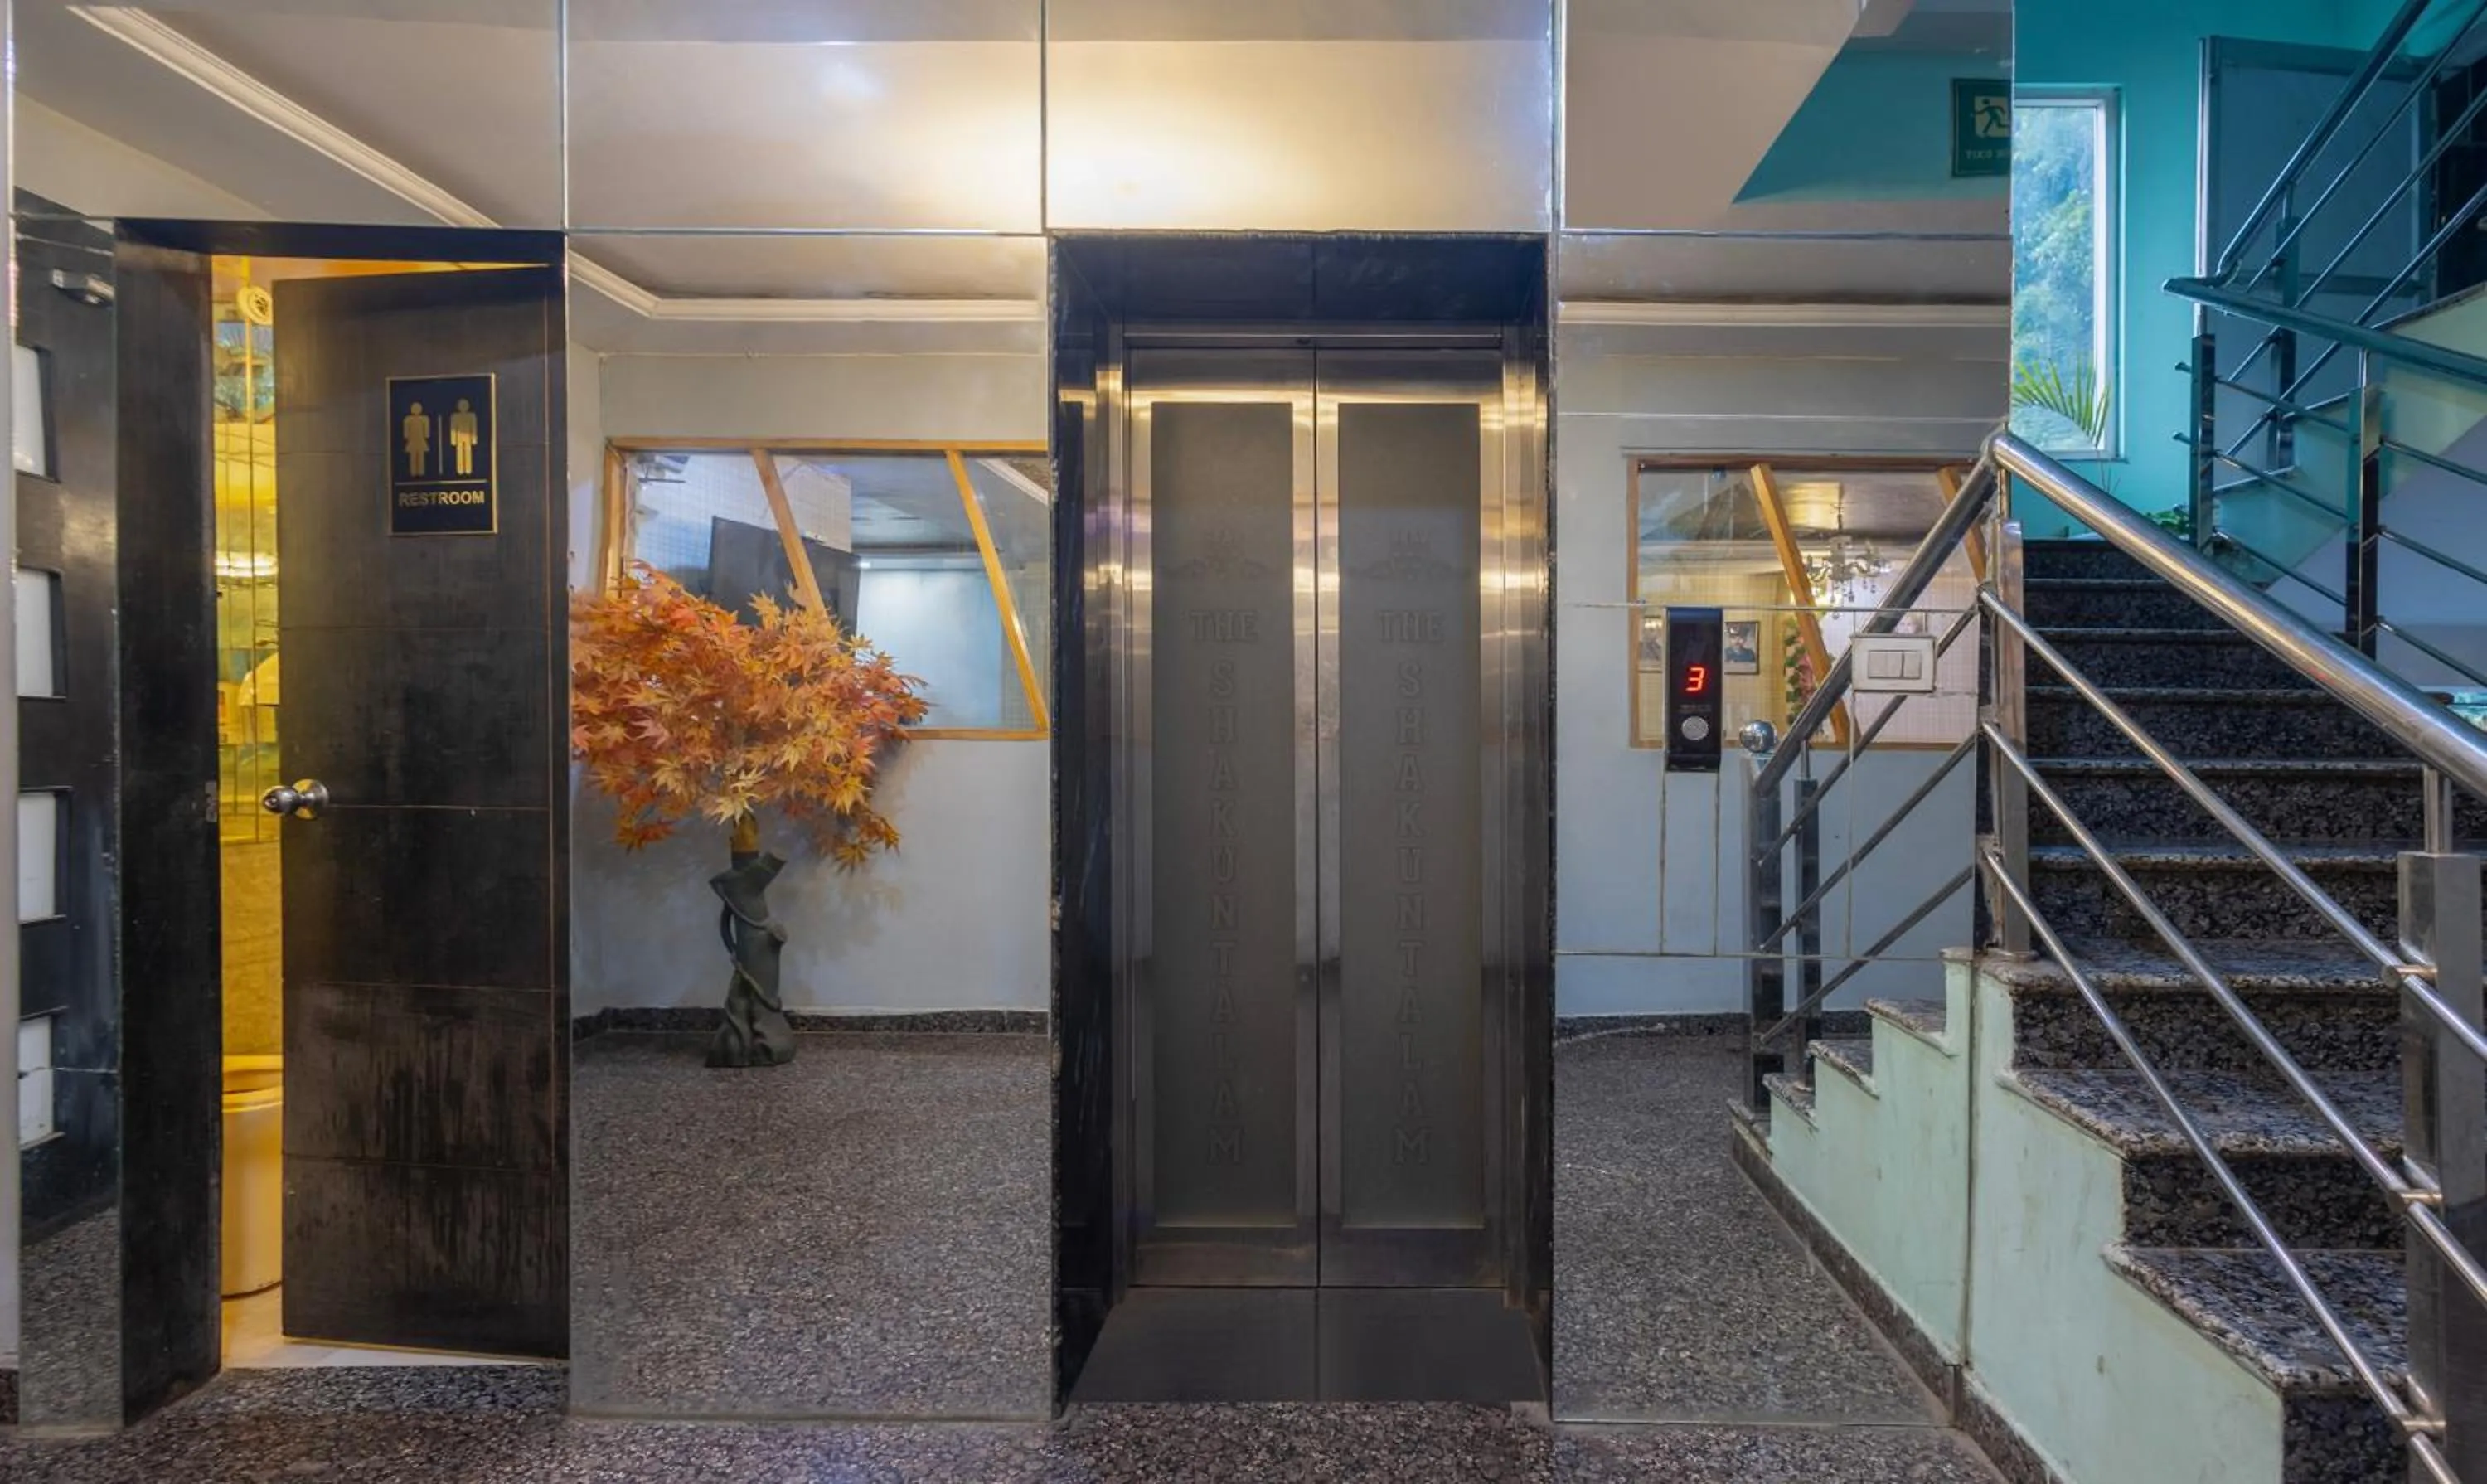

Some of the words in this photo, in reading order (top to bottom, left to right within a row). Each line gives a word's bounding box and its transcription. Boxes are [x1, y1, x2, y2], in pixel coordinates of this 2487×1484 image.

[399, 491, 485, 507] RESTROOM
[1190, 609, 1259, 643] THE
[1379, 609, 1446, 643] THE
[1685, 667, 1706, 691] 3
[1207, 661, 1245, 1166] SHAKUNTALAM
[1391, 662, 1433, 1167] SHAKUNTALAM
